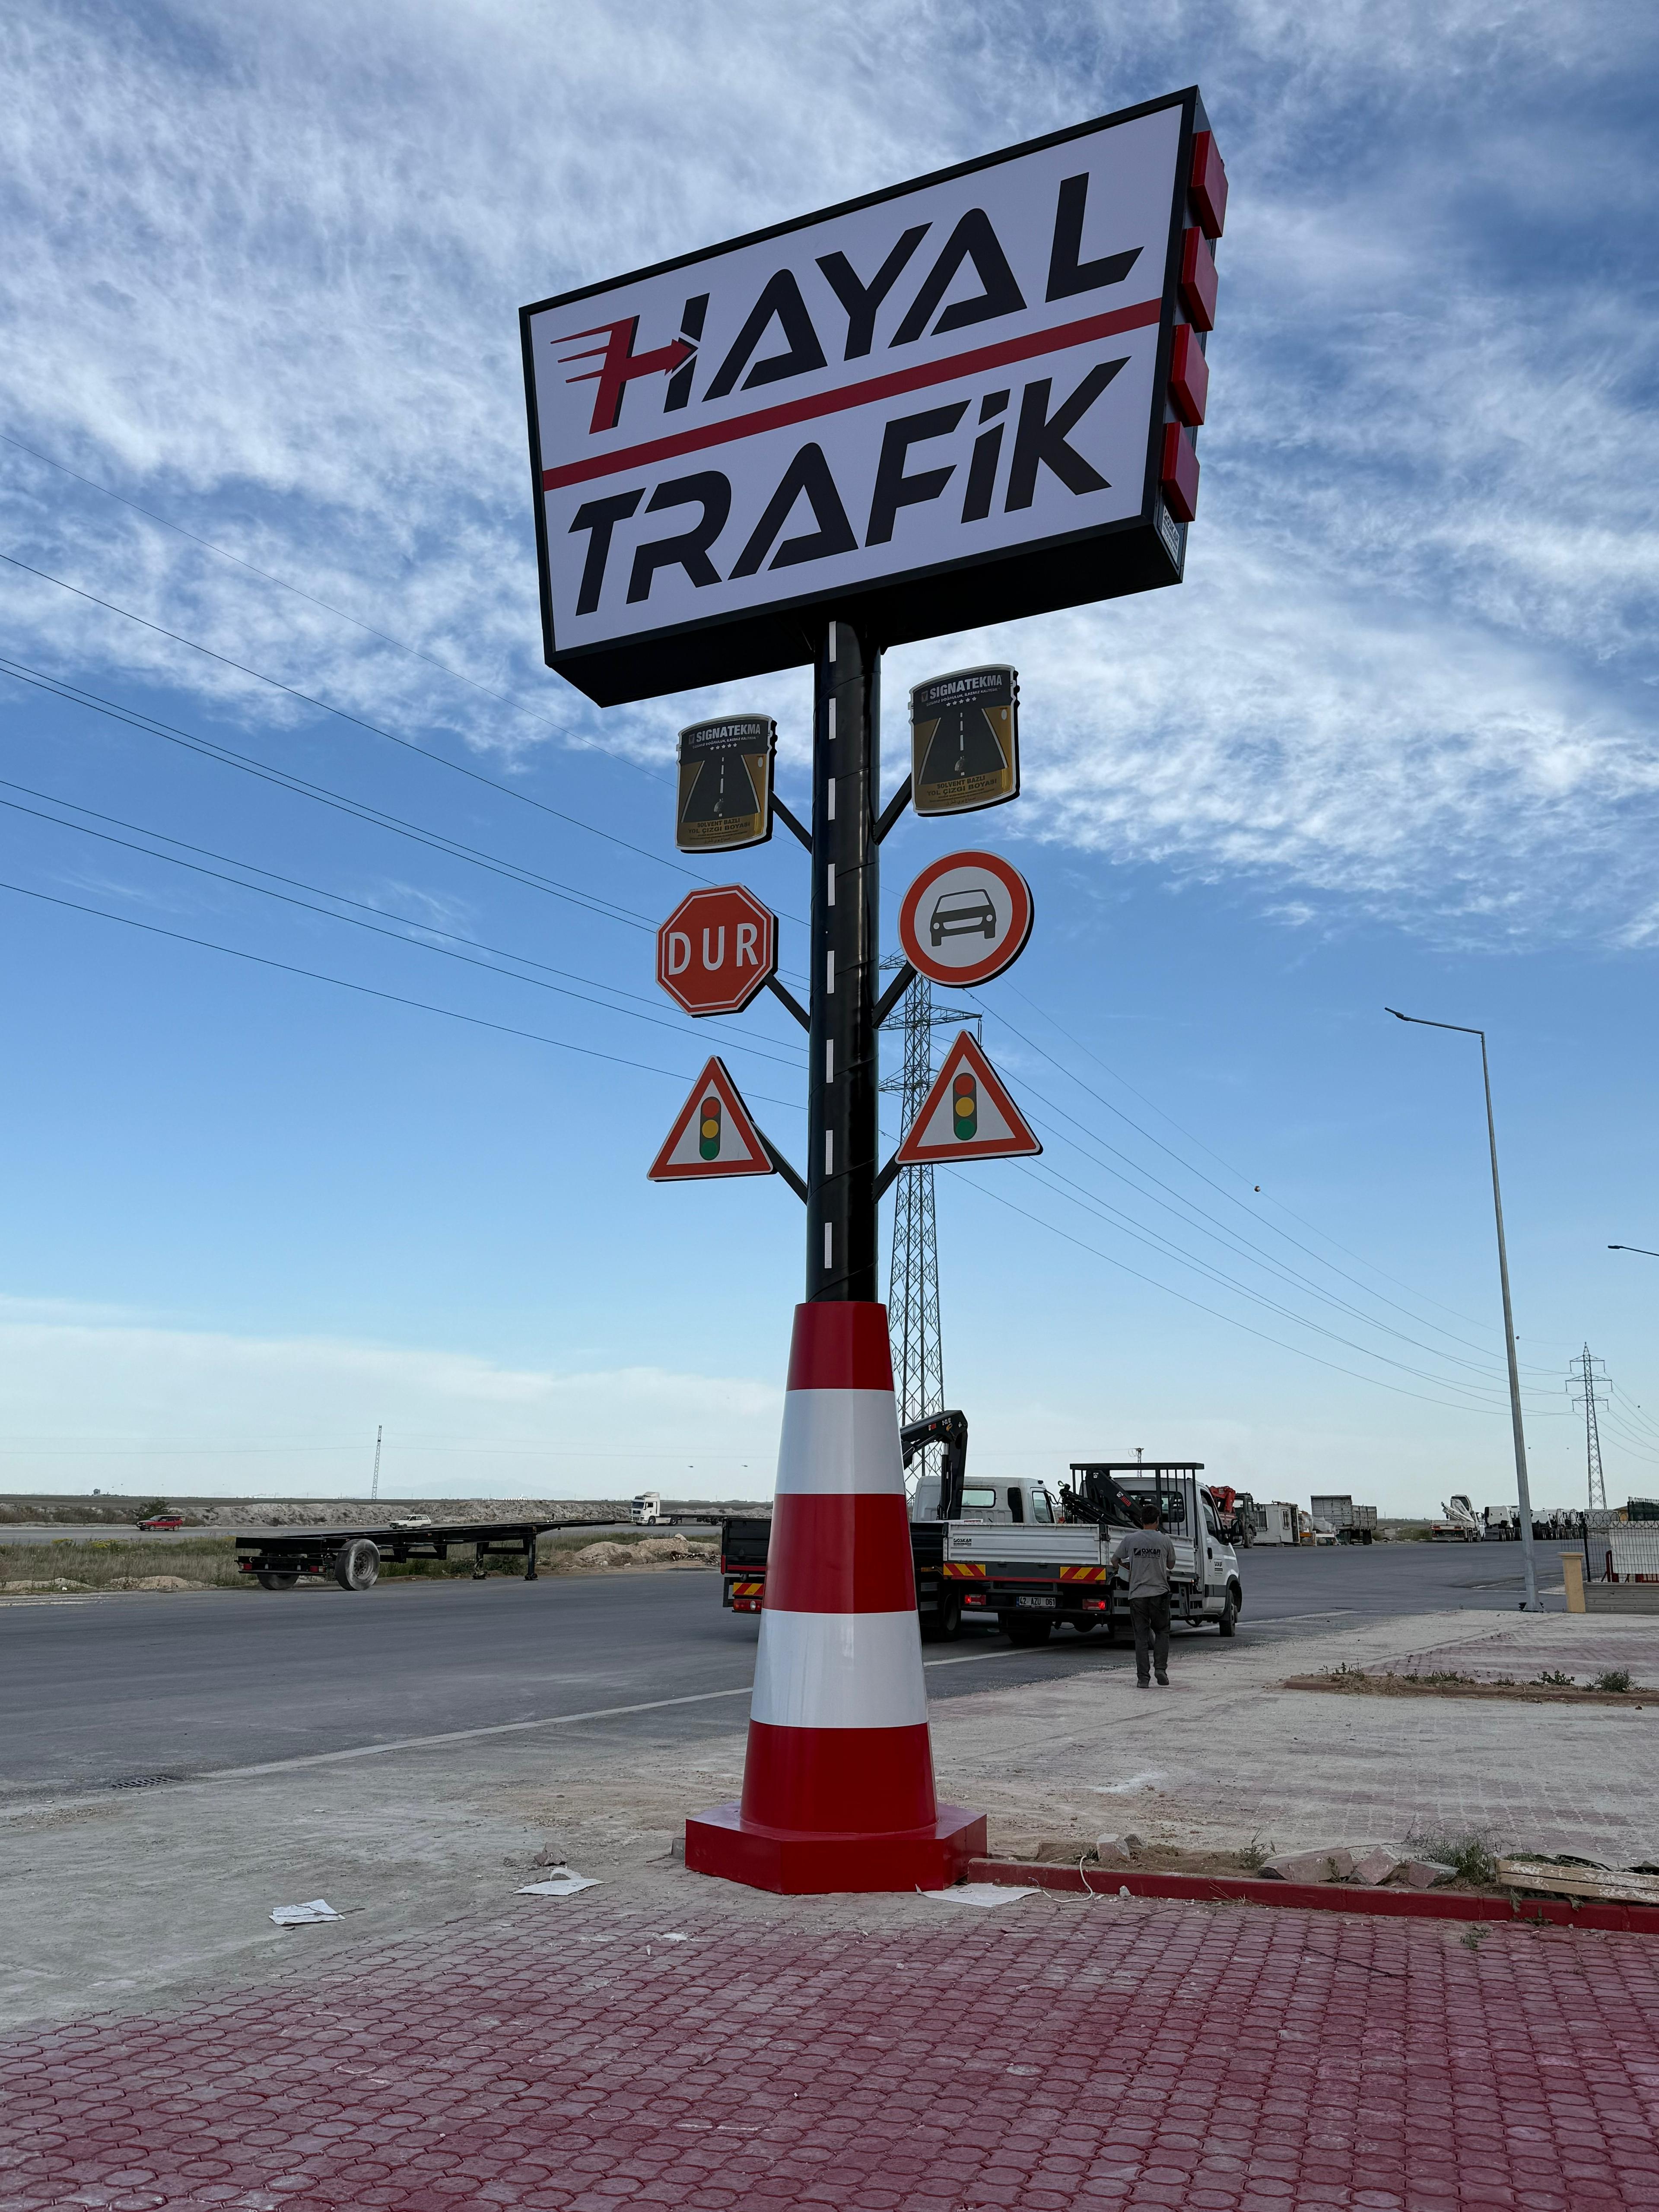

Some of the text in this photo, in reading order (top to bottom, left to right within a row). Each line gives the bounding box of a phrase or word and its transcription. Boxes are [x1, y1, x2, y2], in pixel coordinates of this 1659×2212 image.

[550, 172, 1144, 434] HAYAL
[930, 675, 1002, 699] SIGNATEKMA
[696, 724, 760, 742] SIGNATEKMA
[937, 775, 985, 789] SOLVENT BAZLI
[968, 779, 997, 790] BOYASI
[725, 822, 750, 830] BOYASI
[668, 923, 759, 976] DUR
[1031, 1597, 1041, 1605] AZU
